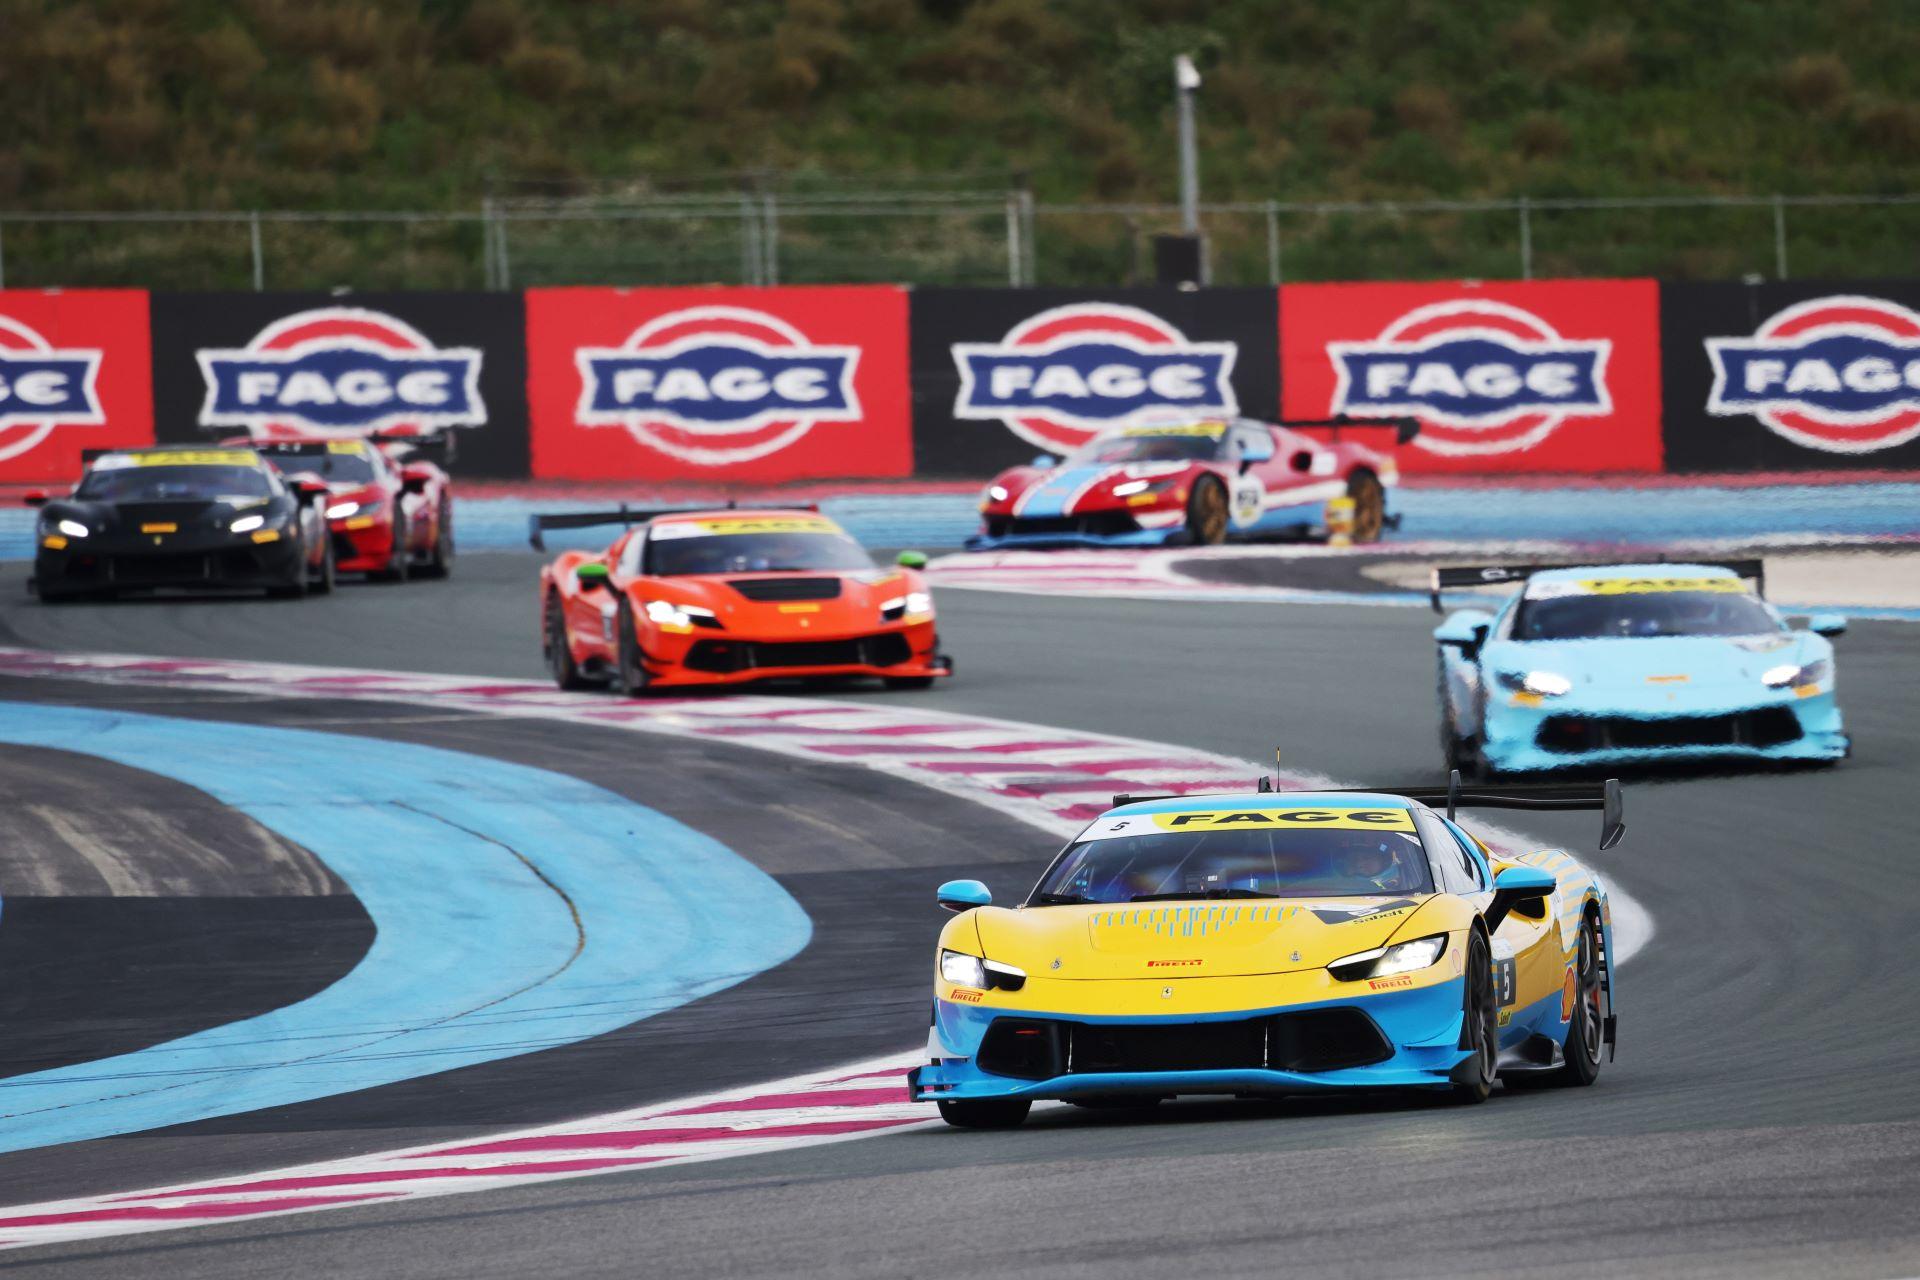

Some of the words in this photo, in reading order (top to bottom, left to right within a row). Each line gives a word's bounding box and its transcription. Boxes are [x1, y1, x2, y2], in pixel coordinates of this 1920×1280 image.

[238, 370, 451, 406] FAGE
[613, 366, 830, 404] FAGE
[991, 363, 1207, 400] FAGE
[1366, 361, 1579, 398] FAGE
[1109, 821, 1131, 832] 5
[1168, 811, 1404, 826] FAGE
[1368, 975, 1413, 991] PIRELLI
[1503, 963, 1510, 1001] 5
